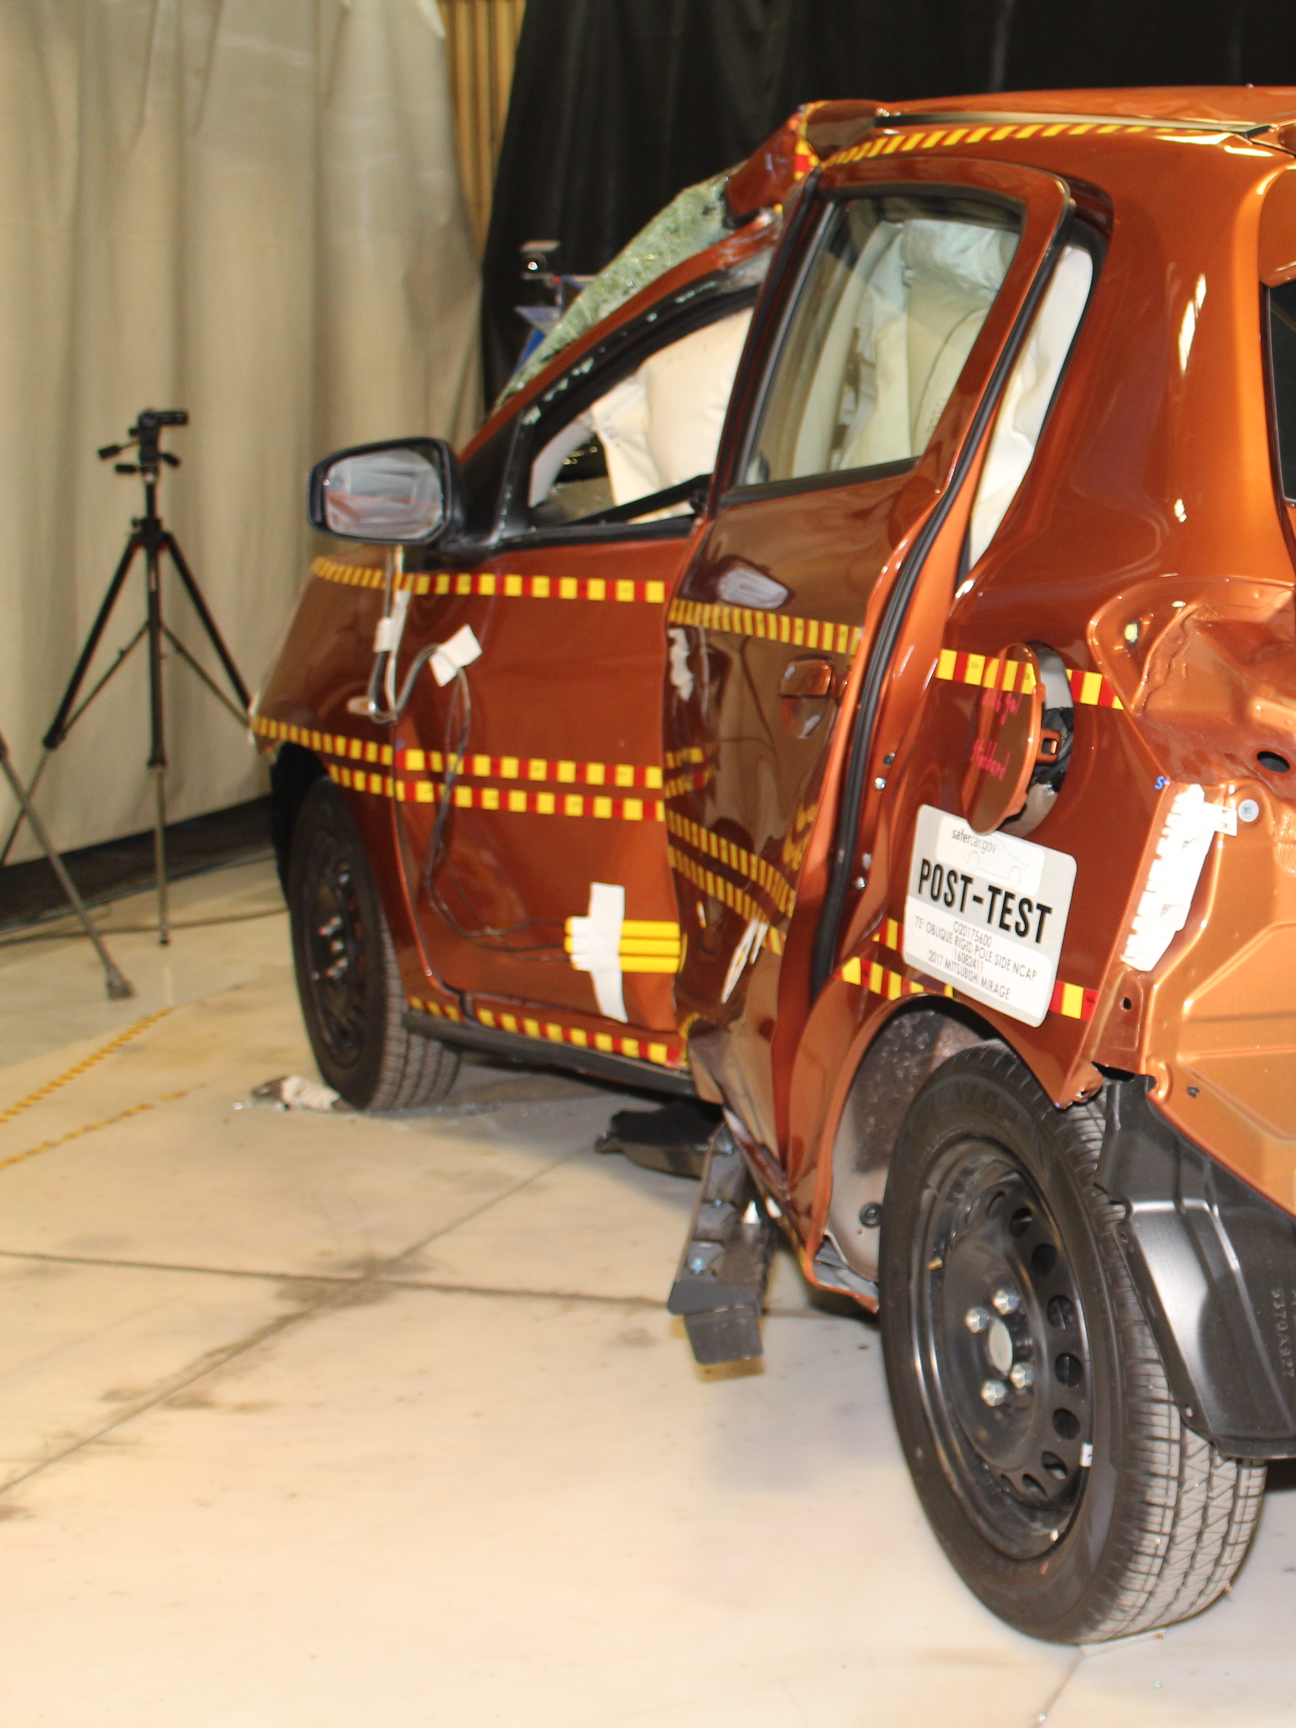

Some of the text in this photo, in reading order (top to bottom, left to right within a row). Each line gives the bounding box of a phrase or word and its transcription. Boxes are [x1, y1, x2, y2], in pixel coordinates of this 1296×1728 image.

[951, 827, 999, 855] safercar.gov
[917, 858, 1053, 944] POST-TEST
[926, 921, 954, 945] OBLIQUE
[954, 935, 974, 954] RIGID
[975, 946, 993, 963] POLE
[994, 953, 1012, 972] SIDE
[1012, 961, 1038, 982] NCAP
[928, 949, 1011, 1001] 2017 MITSUBISHI MIRAGE
